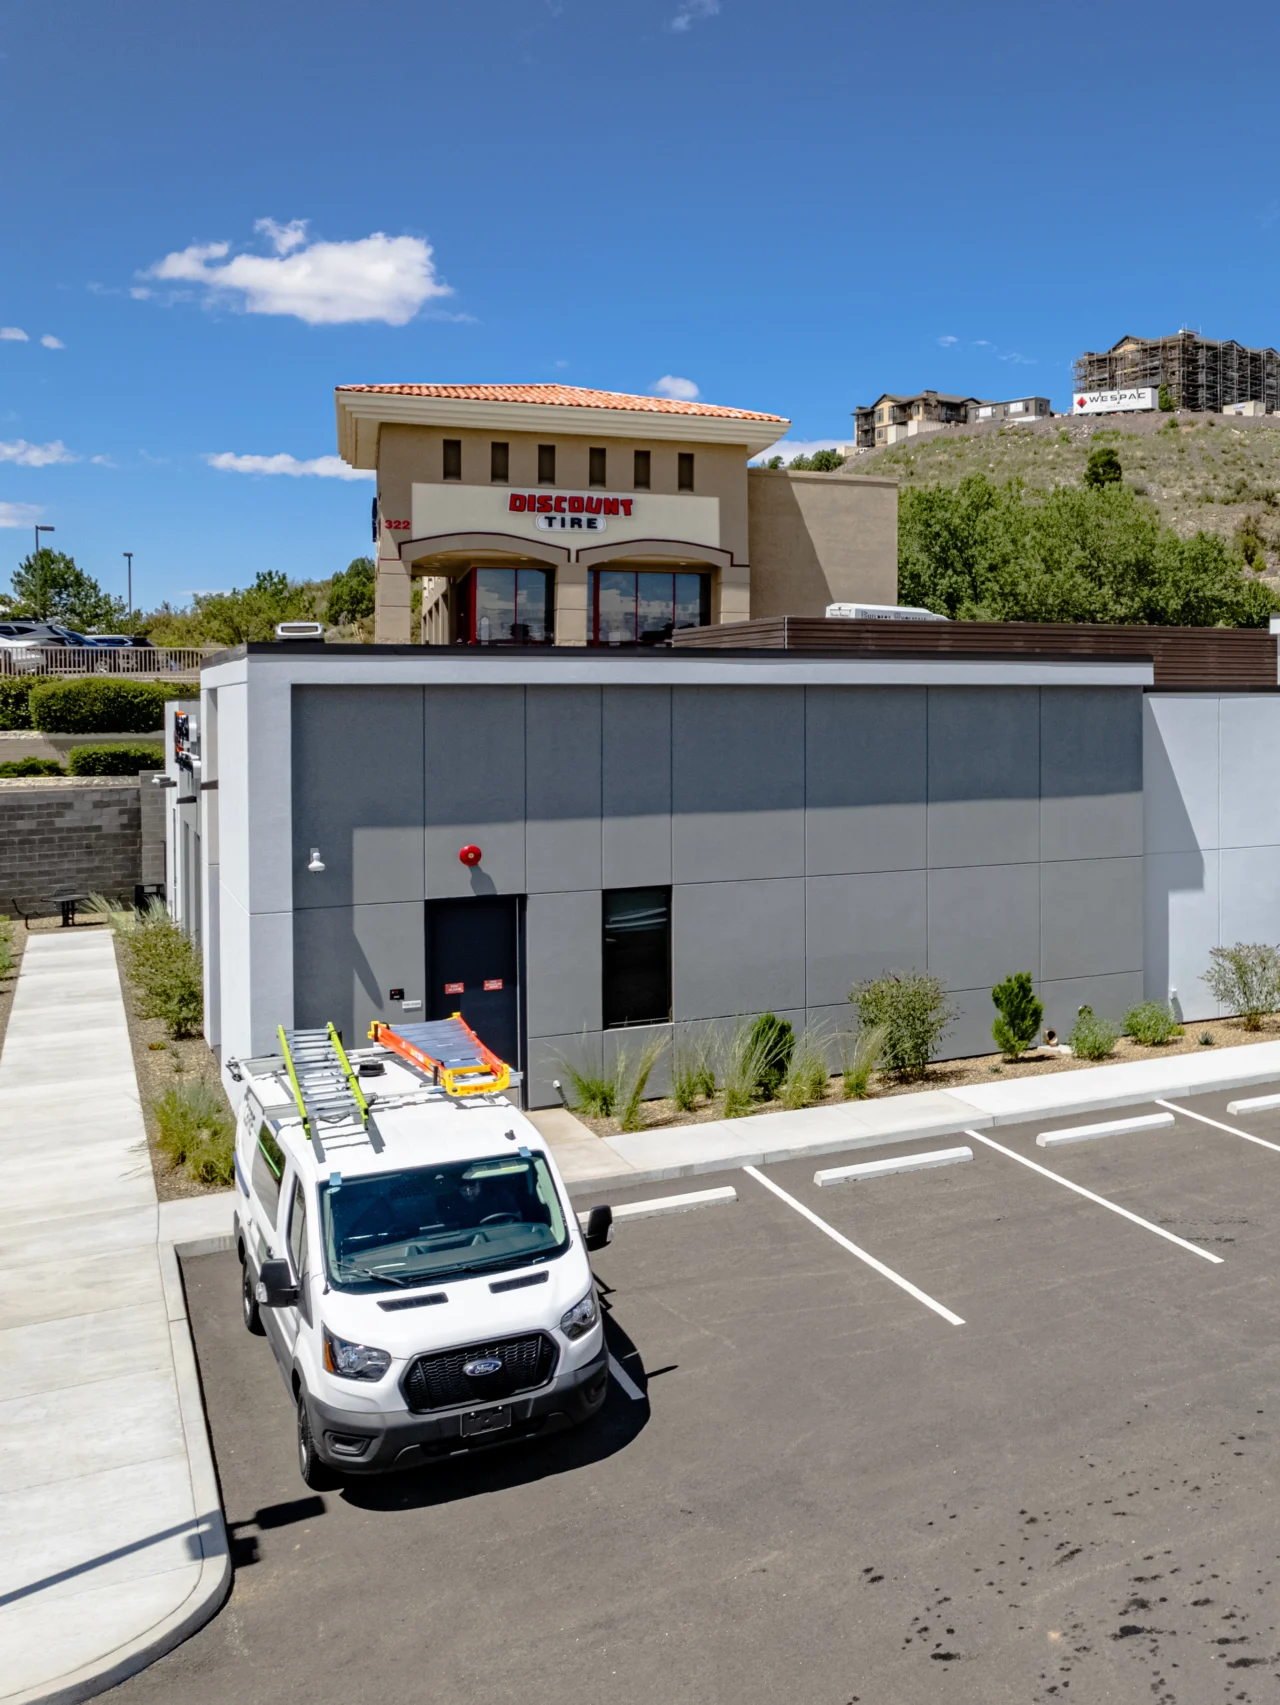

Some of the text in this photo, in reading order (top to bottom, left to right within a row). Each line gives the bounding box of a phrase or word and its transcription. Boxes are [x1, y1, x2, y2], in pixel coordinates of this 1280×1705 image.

[1089, 392, 1146, 403] WESPAC
[509, 493, 633, 517] DISCOUNT
[385, 519, 411, 530] 322
[544, 516, 598, 529] TIRE
[474, 1363, 495, 1374] Ford
